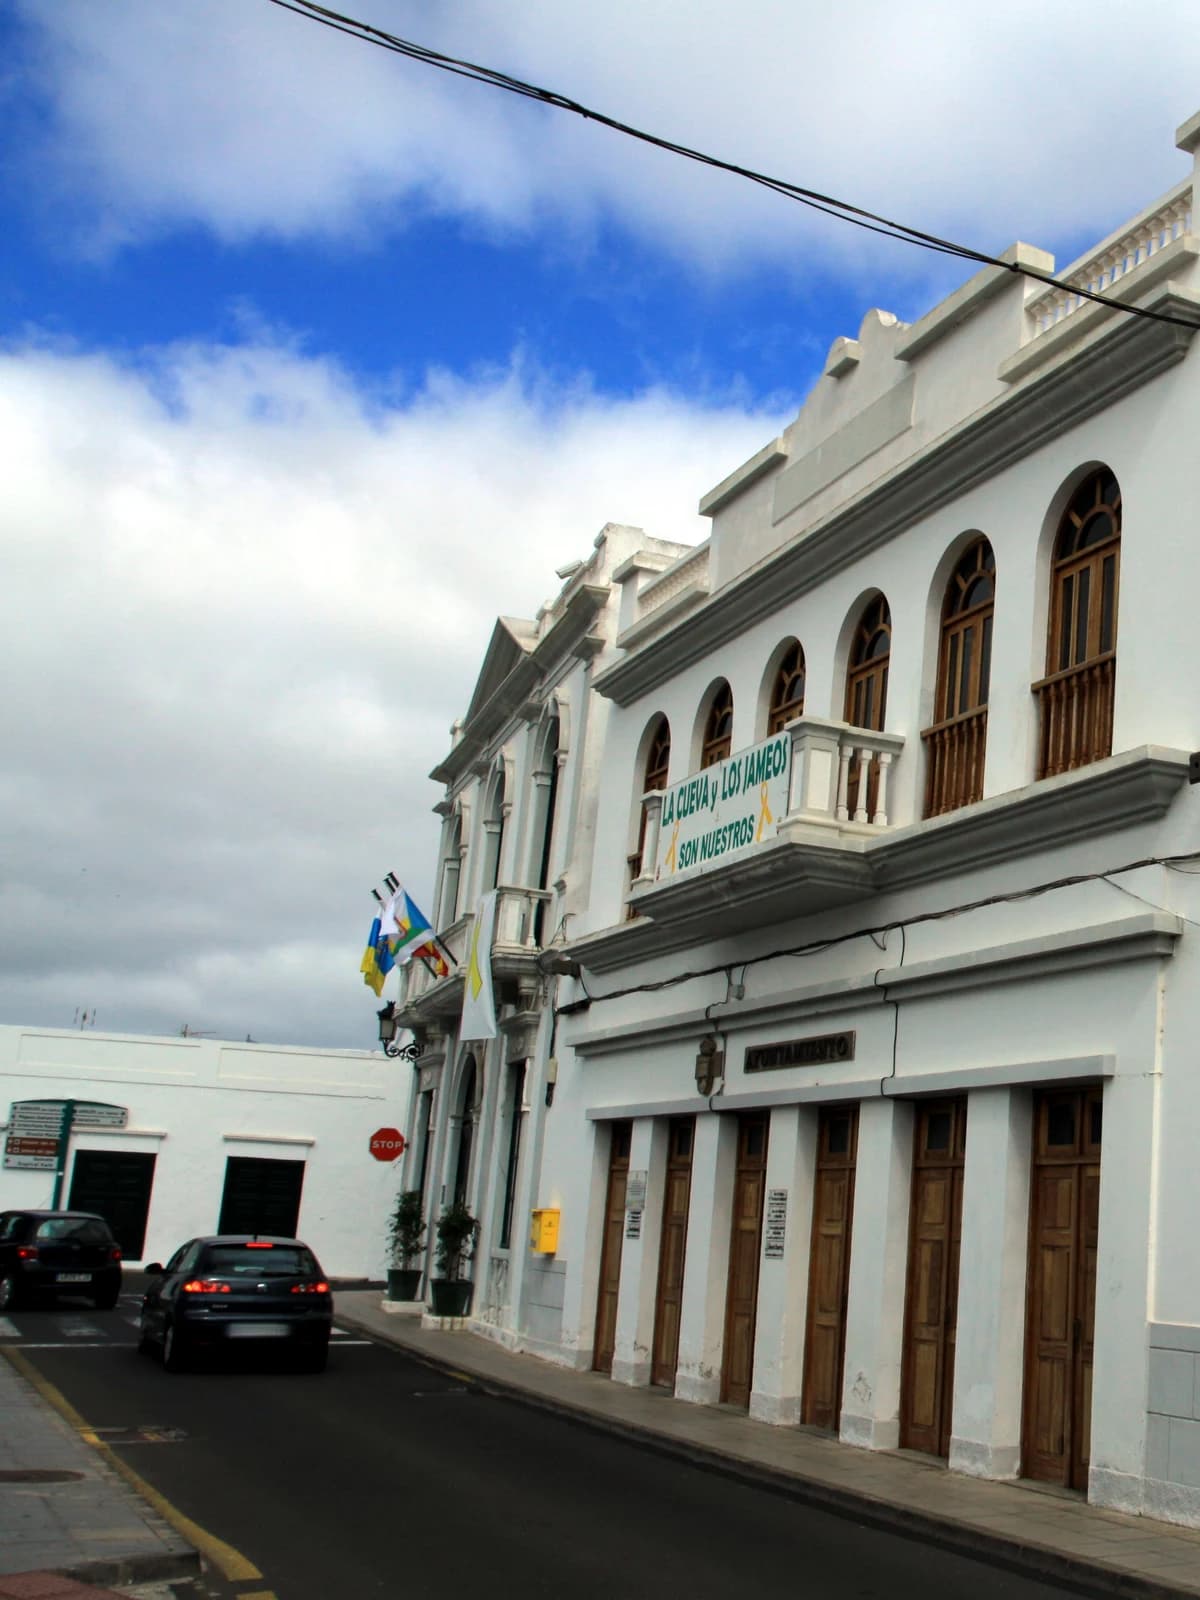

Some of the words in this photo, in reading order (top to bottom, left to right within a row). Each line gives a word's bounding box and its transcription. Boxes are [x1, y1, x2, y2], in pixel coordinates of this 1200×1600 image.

[662, 792, 674, 827] LA
[677, 775, 708, 820] CUEVA
[721, 760, 742, 800] LOS
[743, 736, 788, 793] JAMEOS
[678, 838, 699, 870] SON
[700, 814, 755, 861] NUESTROS
[372, 1140, 402, 1149] STOP
